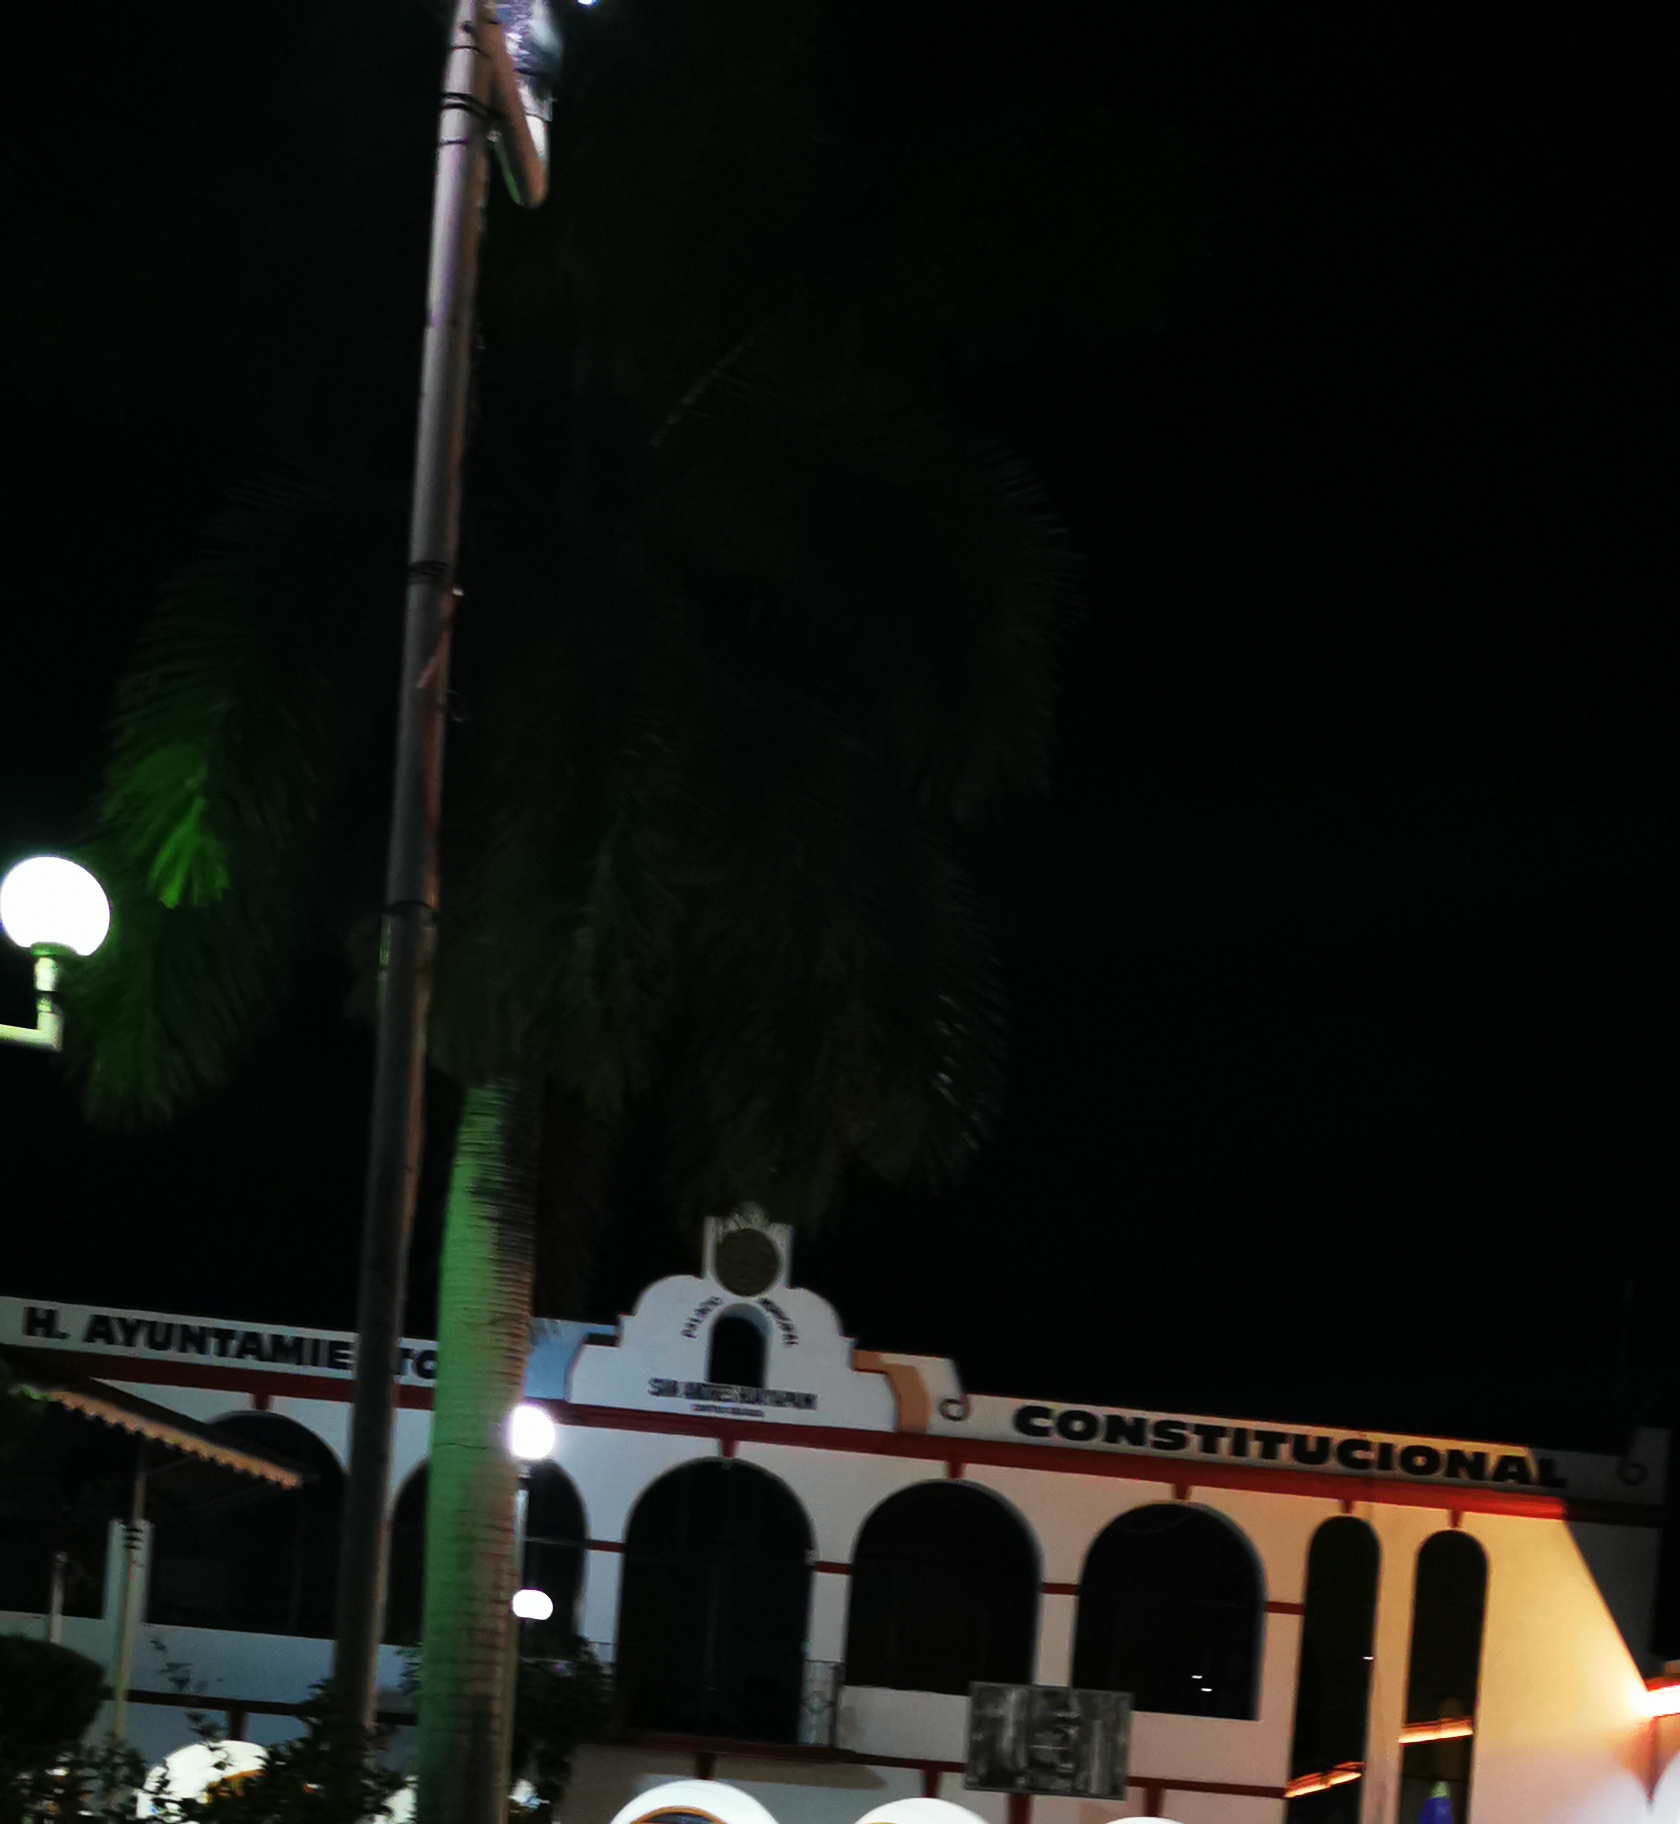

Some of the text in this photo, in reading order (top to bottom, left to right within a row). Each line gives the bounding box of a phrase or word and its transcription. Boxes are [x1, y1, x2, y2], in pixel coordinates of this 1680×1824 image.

[22, 1306, 436, 1379] H. AYUNTAMIETO
[1013, 1403, 1569, 1489] CONSTITUCIONAL
